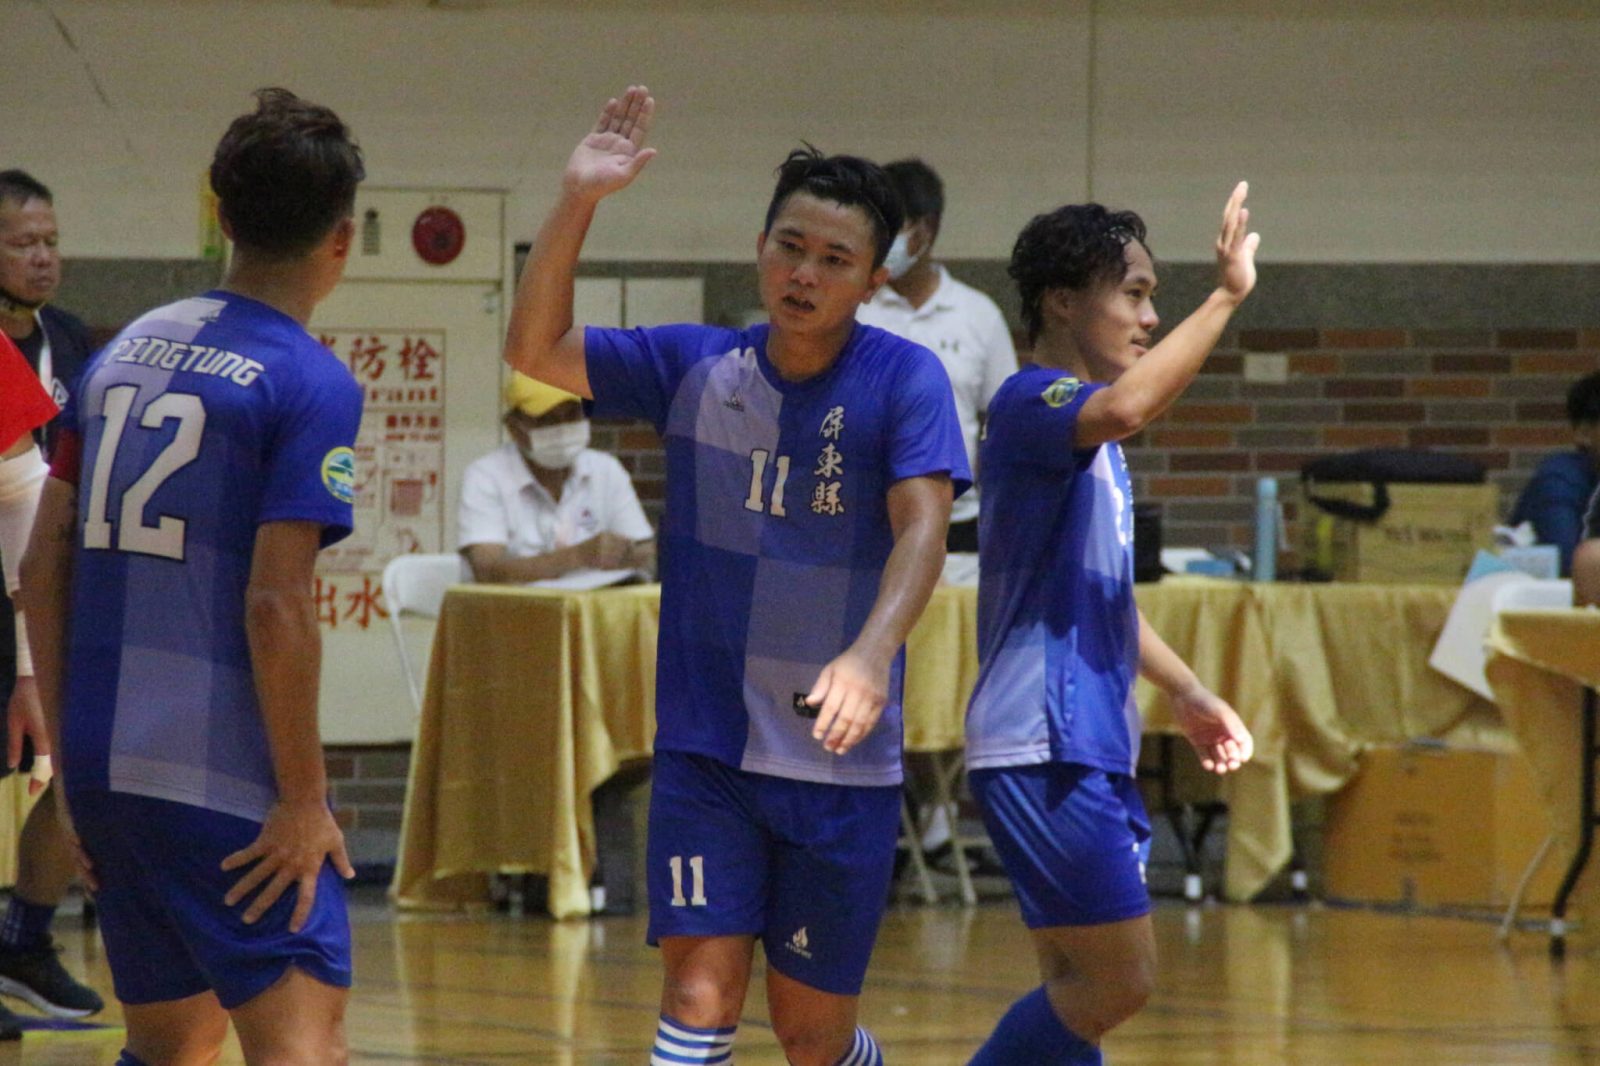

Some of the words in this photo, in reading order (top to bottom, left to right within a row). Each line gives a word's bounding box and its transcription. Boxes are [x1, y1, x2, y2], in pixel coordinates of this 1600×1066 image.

[103, 336, 265, 387] PINGTUNG
[320, 334, 439, 380] 防栓
[83, 382, 207, 562] 12
[744, 449, 791, 518] 11
[810, 405, 845, 517] 屏東縣
[669, 855, 708, 907] 11
